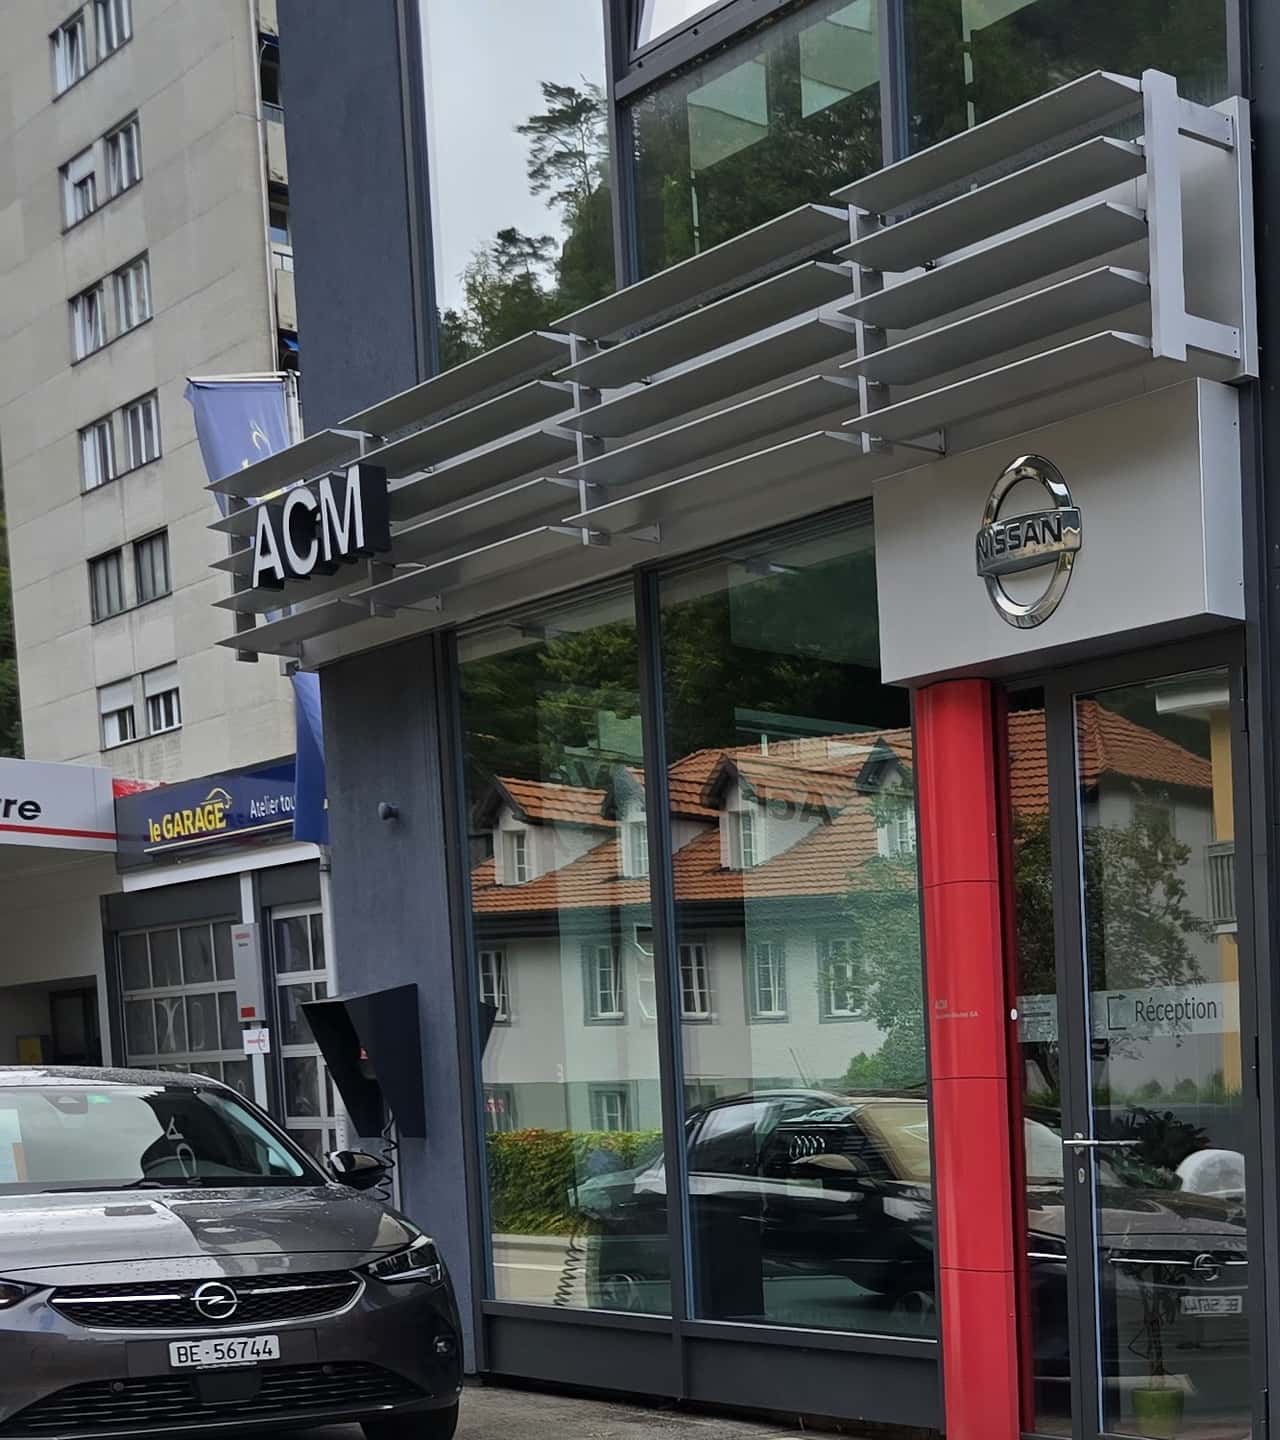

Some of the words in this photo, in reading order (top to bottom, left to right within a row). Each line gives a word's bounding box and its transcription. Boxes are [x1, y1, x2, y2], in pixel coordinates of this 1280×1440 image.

[252, 463, 365, 589] ACM
[976, 512, 1064, 563] NISSAN
[0, 798, 42, 821] re
[149, 818, 161, 843] le
[162, 802, 227, 841] GARAGE
[250, 798, 279, 819] Atelier
[1135, 997, 1217, 1025] Réception
